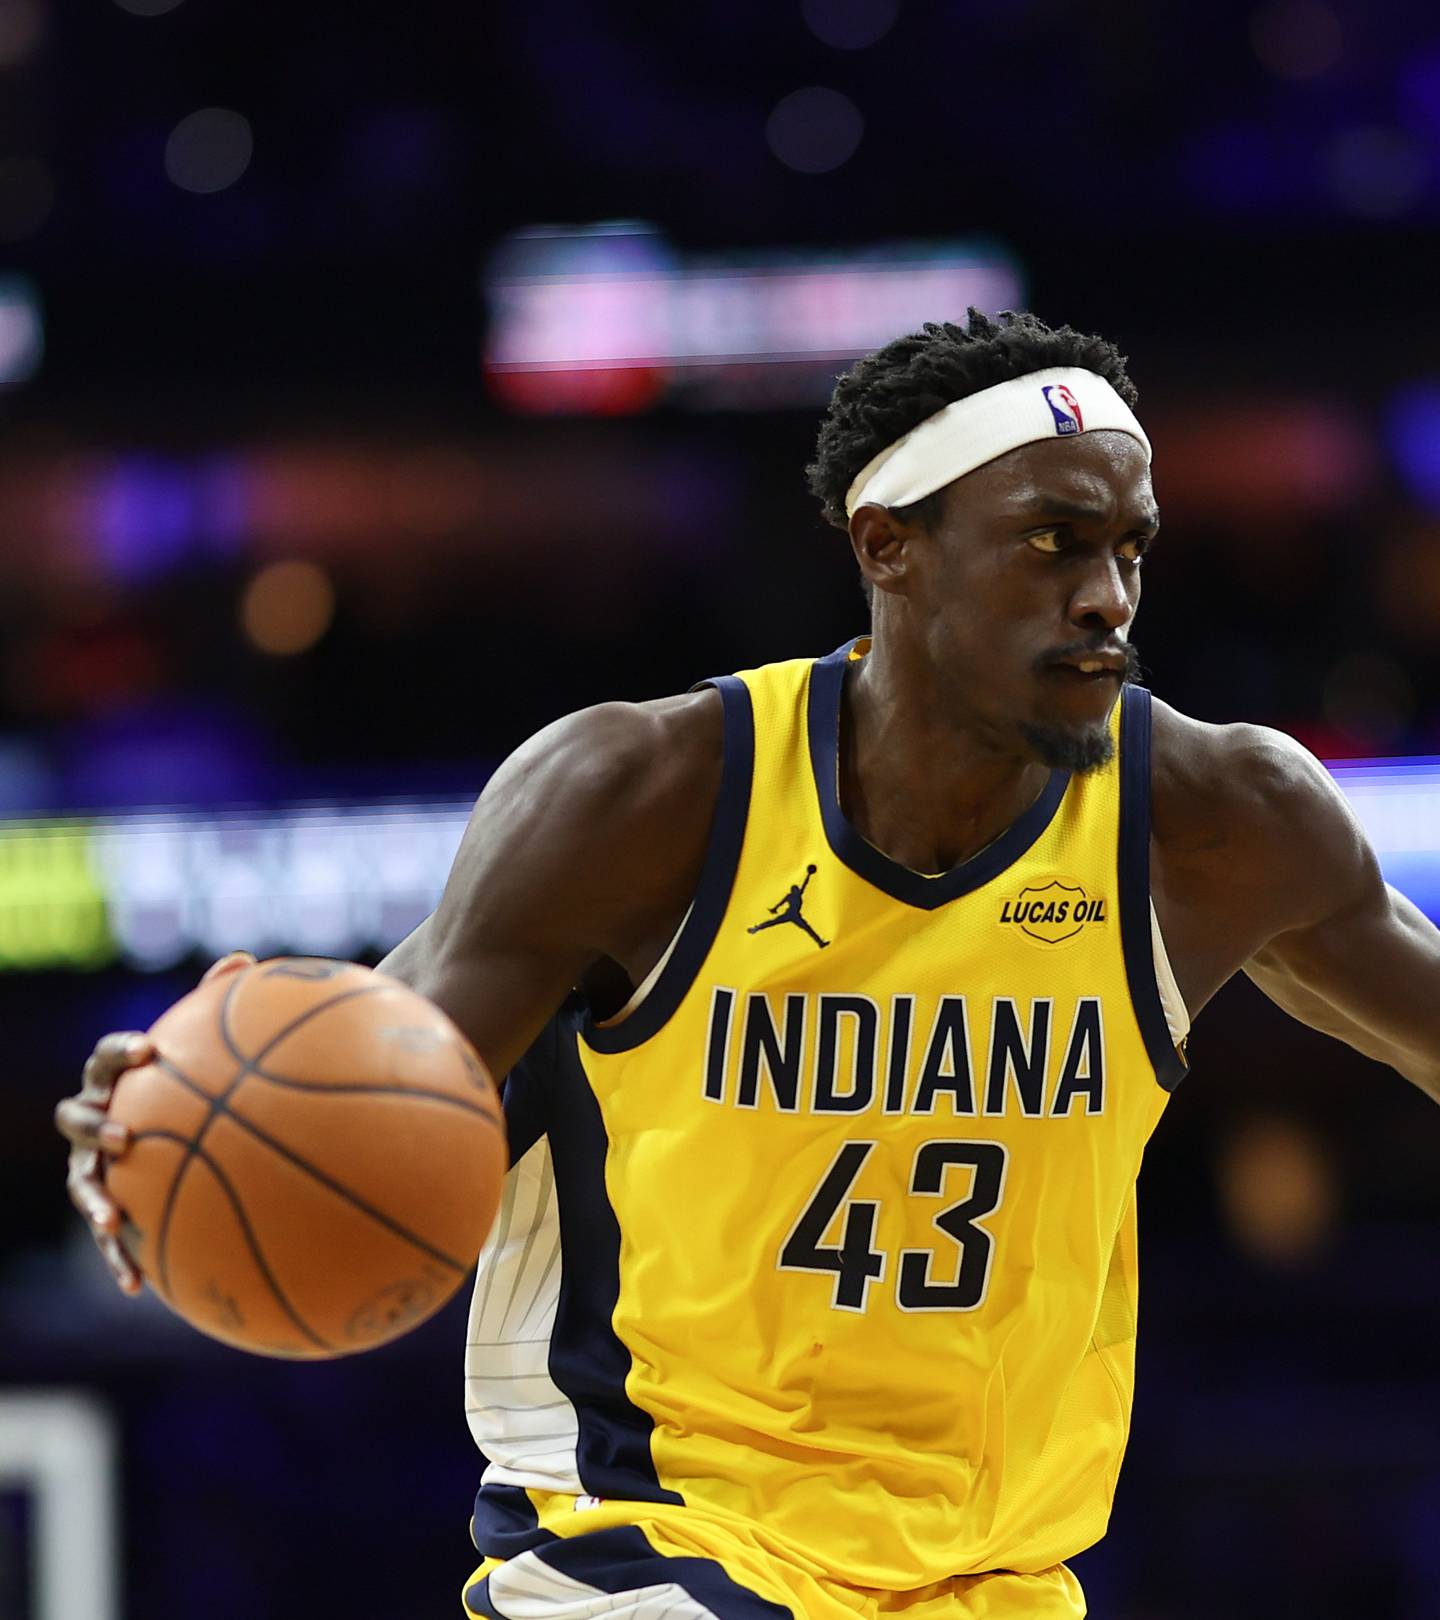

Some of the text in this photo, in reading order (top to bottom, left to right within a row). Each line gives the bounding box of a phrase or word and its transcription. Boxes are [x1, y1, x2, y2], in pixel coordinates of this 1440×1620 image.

[1058, 420, 1077, 433] NBA
[1000, 900, 1105, 923] LUCAS OIL
[703, 984, 1105, 1119] INDIANA
[776, 1138, 1010, 1314] 43
